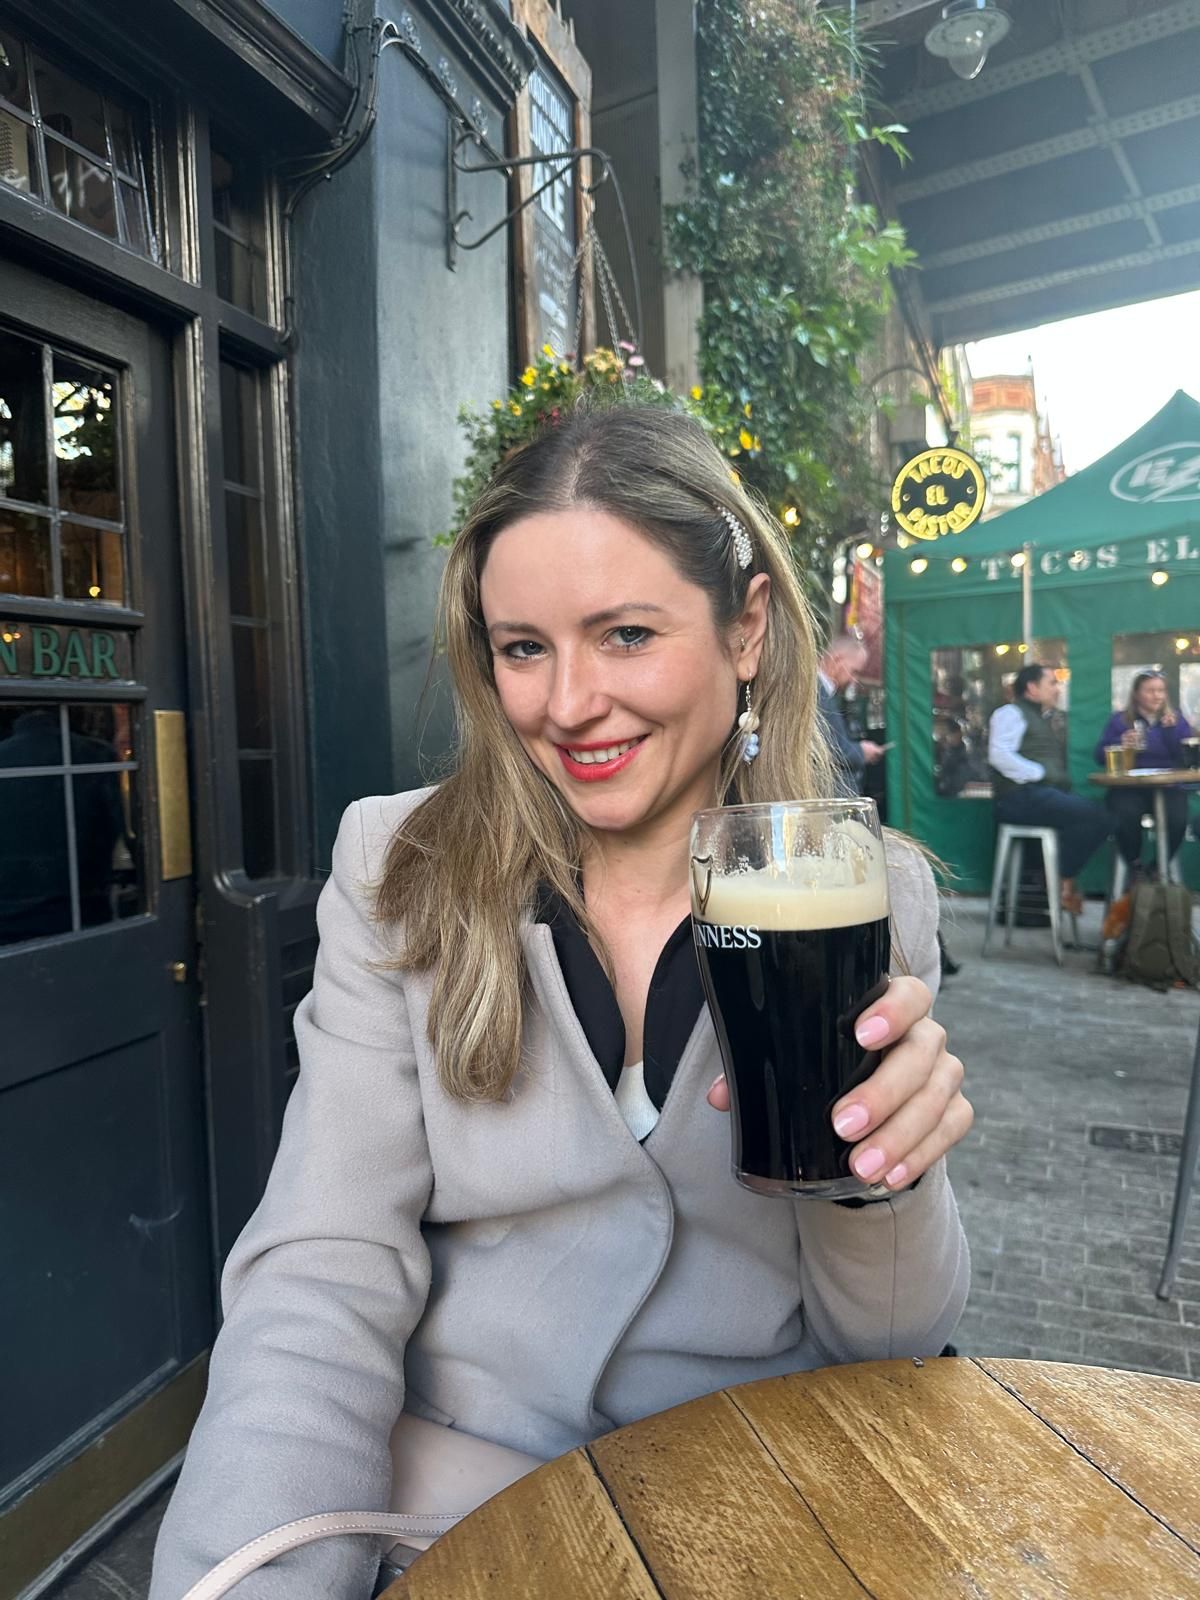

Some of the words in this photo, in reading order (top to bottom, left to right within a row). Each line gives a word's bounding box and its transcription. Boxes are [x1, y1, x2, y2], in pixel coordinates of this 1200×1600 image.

[908, 455, 969, 483] TACOS
[926, 484, 949, 506] EL
[907, 502, 974, 537] PASTOR
[1145, 535, 1200, 563] EL
[30, 625, 119, 678] BAR
